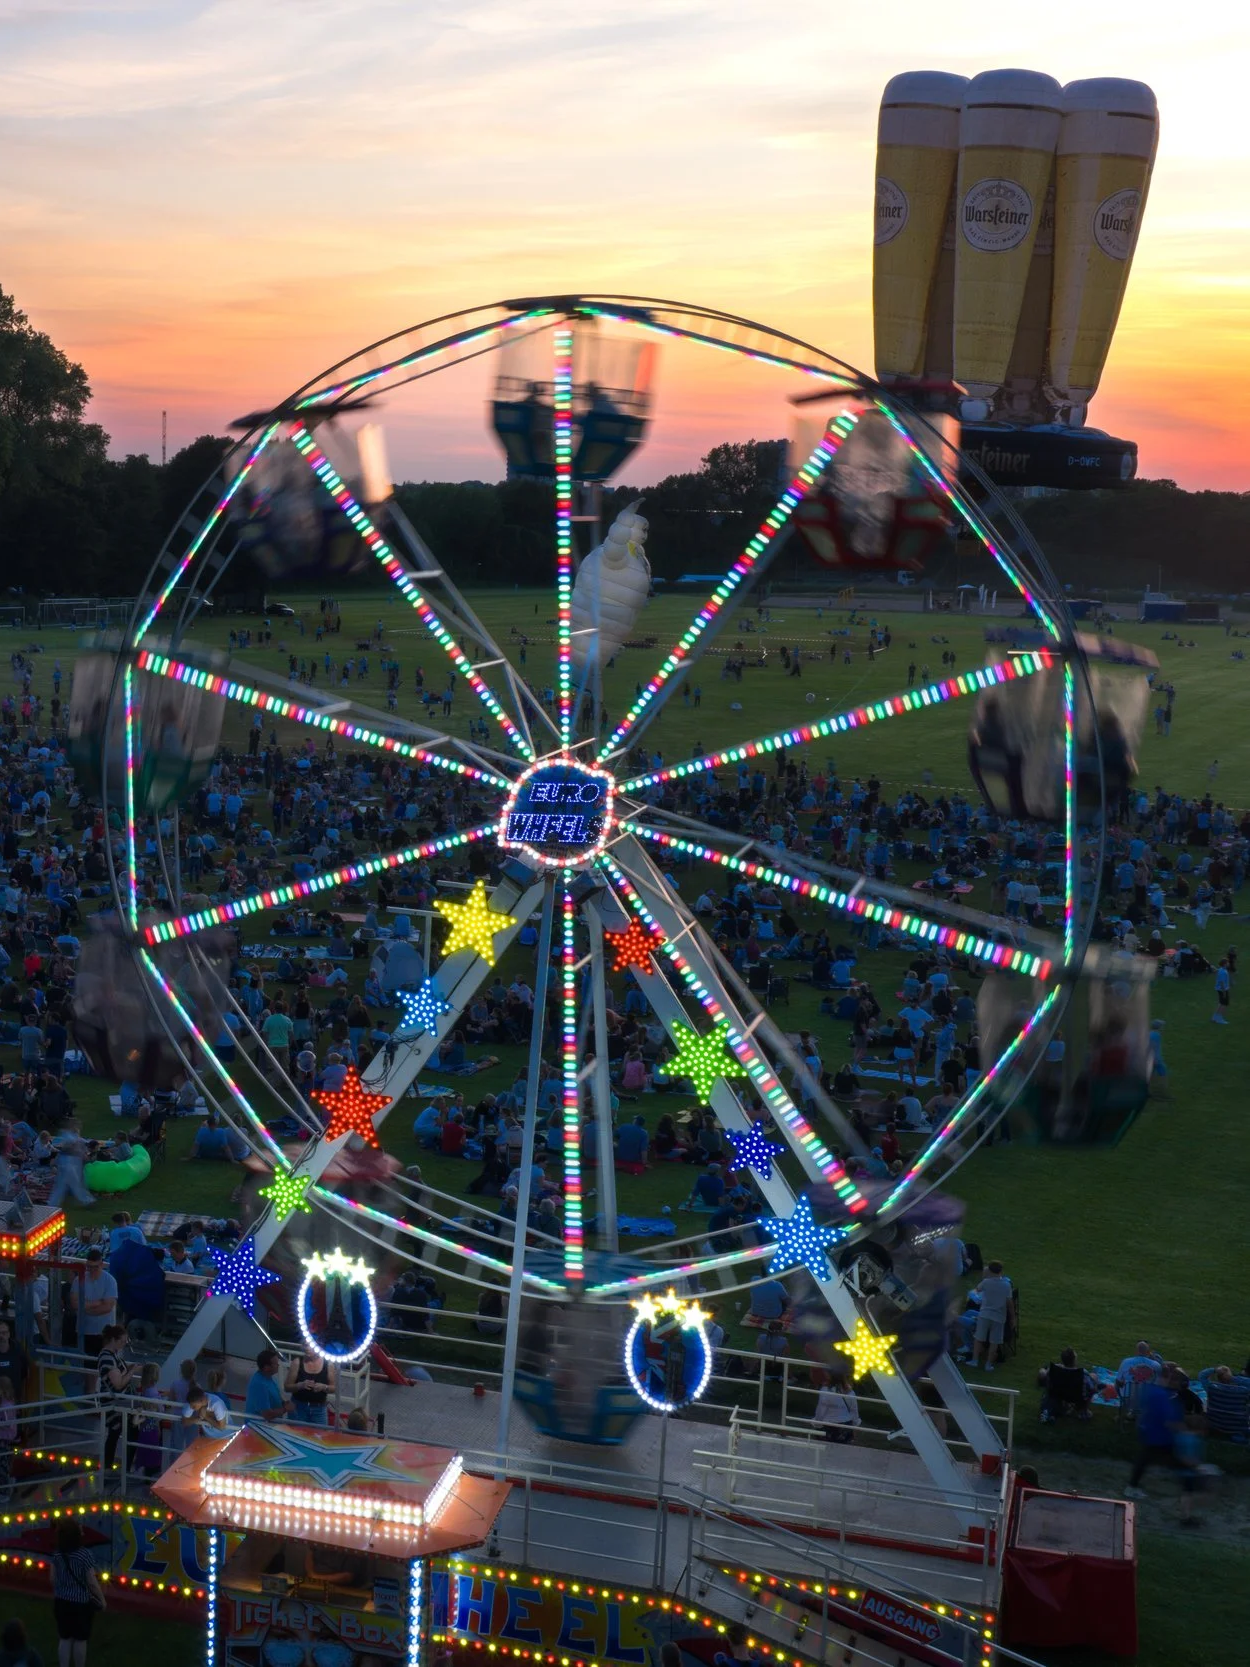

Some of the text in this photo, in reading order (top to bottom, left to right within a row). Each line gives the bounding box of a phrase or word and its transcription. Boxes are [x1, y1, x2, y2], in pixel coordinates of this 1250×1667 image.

[965, 205, 1029, 226] Warsteiner
[529, 783, 600, 803] EURO
[223, 1593, 403, 1650] Ticket Box
[865, 1596, 938, 1639] AUSGANG
